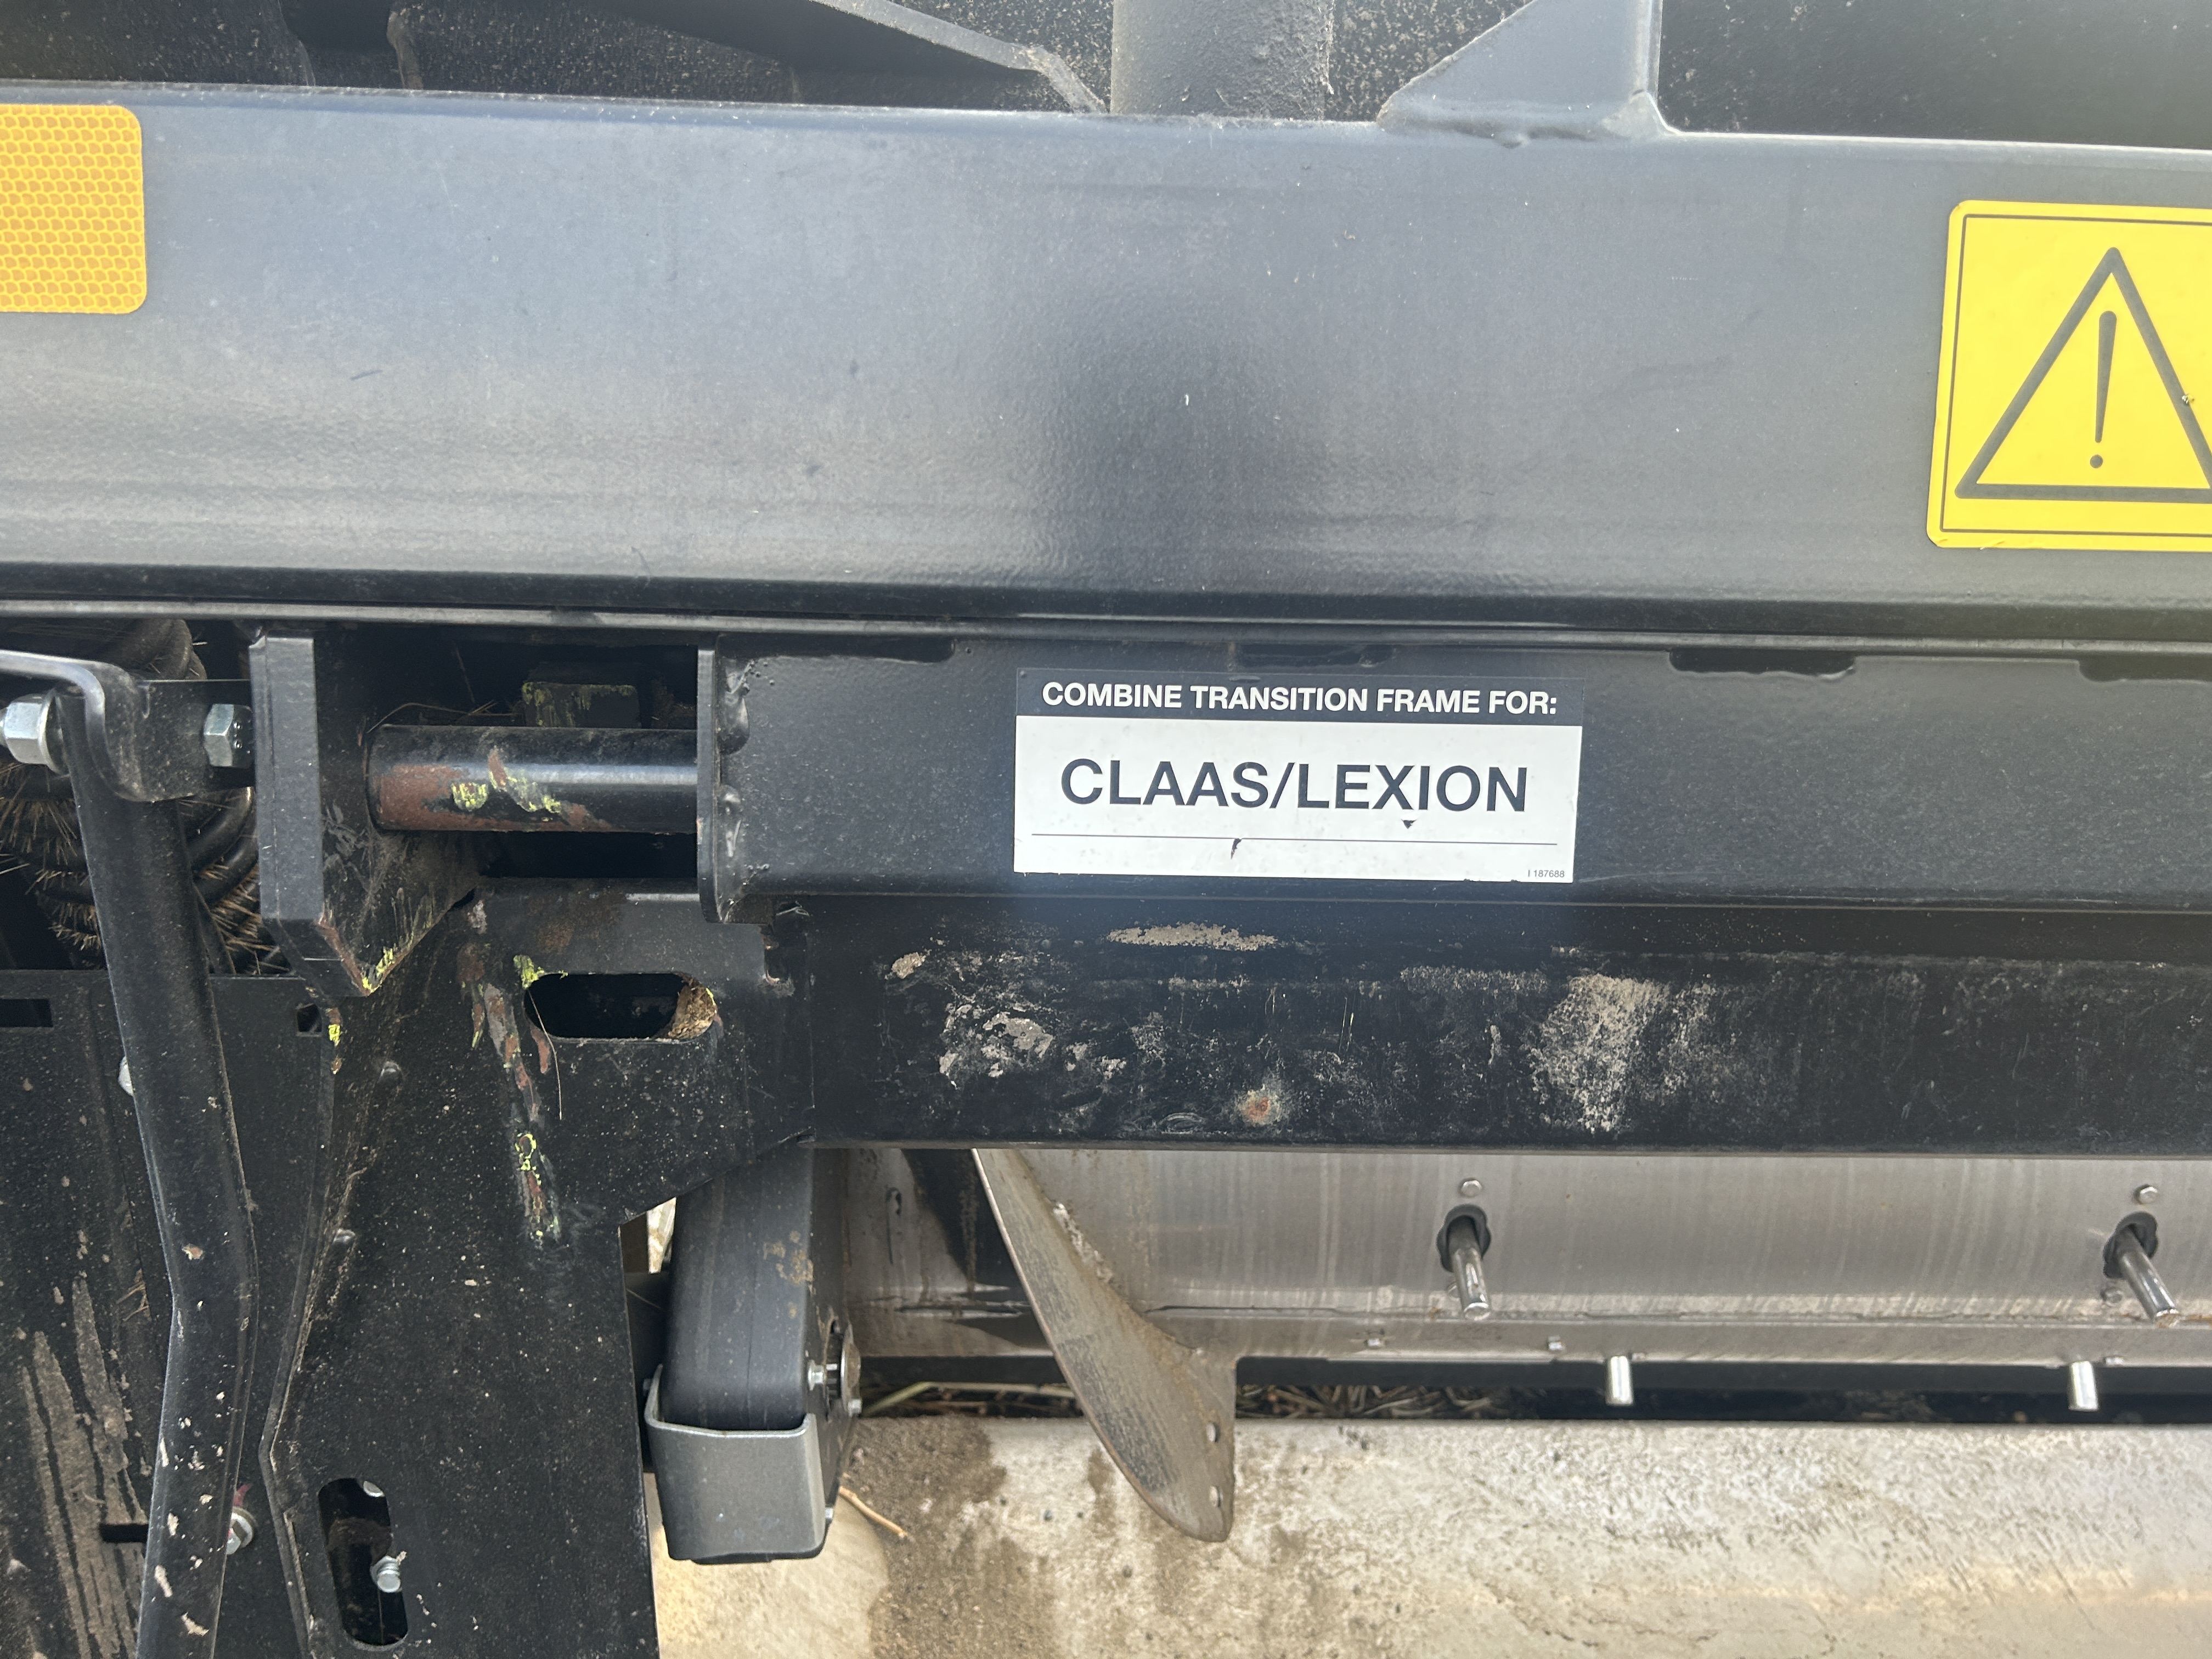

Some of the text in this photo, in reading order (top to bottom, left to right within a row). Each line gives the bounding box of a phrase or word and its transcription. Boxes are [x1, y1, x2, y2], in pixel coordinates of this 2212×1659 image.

[1042, 681, 1558, 715] COMBINE TRANSITION FRAME FOR:
[1060, 758, 1528, 812] CLAAS/LEXION
